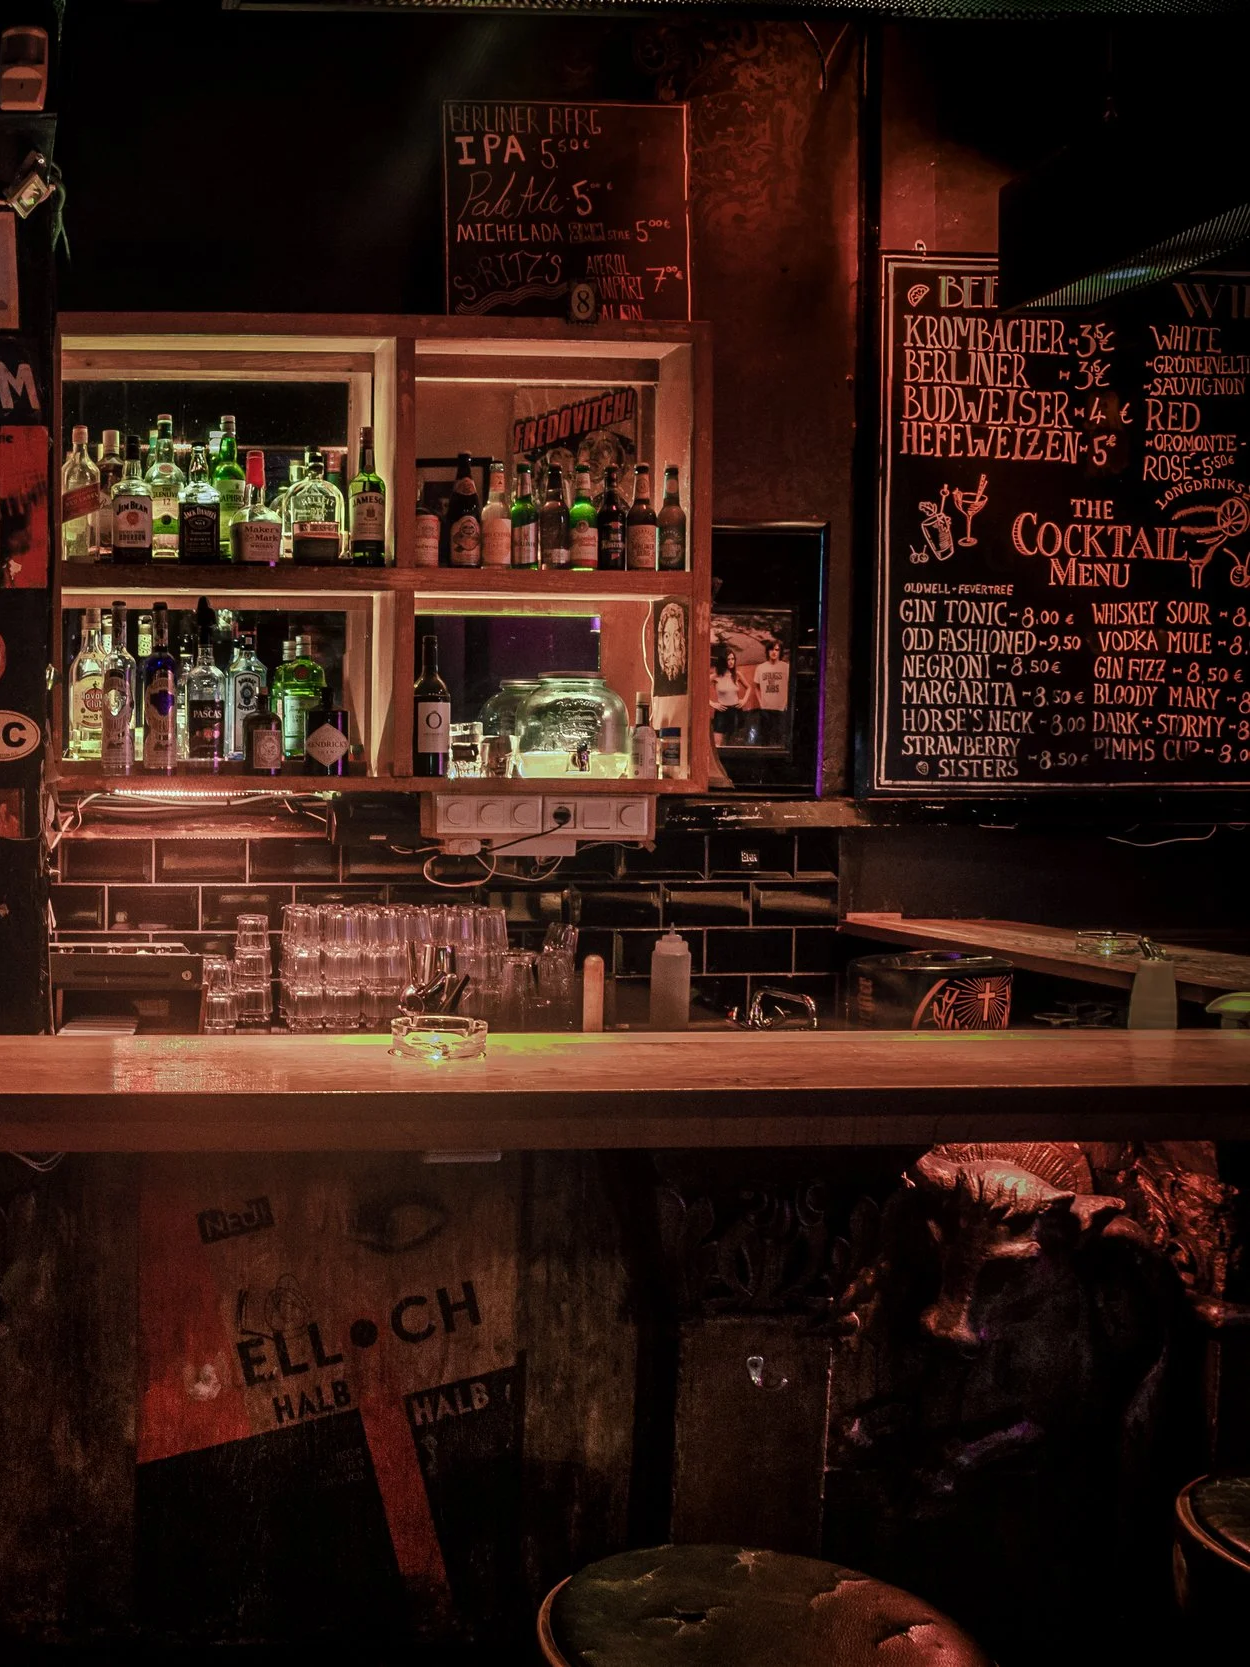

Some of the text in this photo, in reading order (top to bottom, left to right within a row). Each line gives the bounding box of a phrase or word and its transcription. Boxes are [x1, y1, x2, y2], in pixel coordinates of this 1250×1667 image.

[454, 134, 526, 165] IPA
[456, 171, 517, 221] Pale
[456, 223, 564, 243] MICHELADA
[938, 275, 999, 309] BEE
[904, 315, 1069, 356] KROMBACHER
[1149, 325, 1221, 353] WHITE
[904, 350, 1030, 389] BERLINER
[1150, 377, 1246, 396] SAUVIGNON
[901, 385, 1073, 428] BUDWEISER
[1145, 398, 1201, 432] RED
[513, 387, 635, 454] FREDOVITCH!
[900, 422, 1083, 464] HEFEWEIZEN
[1154, 434, 1238, 453] OROMONTE
[130, 501, 148, 514] BEAM
[1155, 478, 1246, 511] LONGDRINKS
[1071, 498, 1114, 520] THE
[255, 534, 279, 542] Mark
[1012, 511, 1188, 562] COCKTAIL
[1049, 558, 1130, 589] MENU
[958, 584, 1014, 595] FEVERTREE
[900, 599, 937, 623] GIN
[944, 600, 1008, 627] TONIC
[1091, 600, 1212, 625] WHISKEY SOUR
[902, 627, 934, 651] OLD
[938, 628, 1036, 654] FASHIONED
[1098, 630, 1212, 654] VODKA MULE
[902, 654, 991, 679] NEGRONI
[1094, 656, 1124, 679] GIN
[1128, 659, 1166, 683] FIZZ
[901, 680, 1017, 706] MARGARITA
[1094, 683, 1159, 707] BLOODY
[1169, 686, 1221, 710] MARY
[193, 710, 222, 719] PASCAS
[902, 709, 1034, 734] HORSE'S NECK
[1093, 711, 1141, 735] DARK
[1156, 714, 1226, 738] STORMY
[902, 736, 1020, 757] STRAWBERRY
[1092, 737, 1200, 761] PIMMS CUP
[938, 759, 1019, 778] SISTERS
[273, 1381, 492, 1427] HALB HALB
